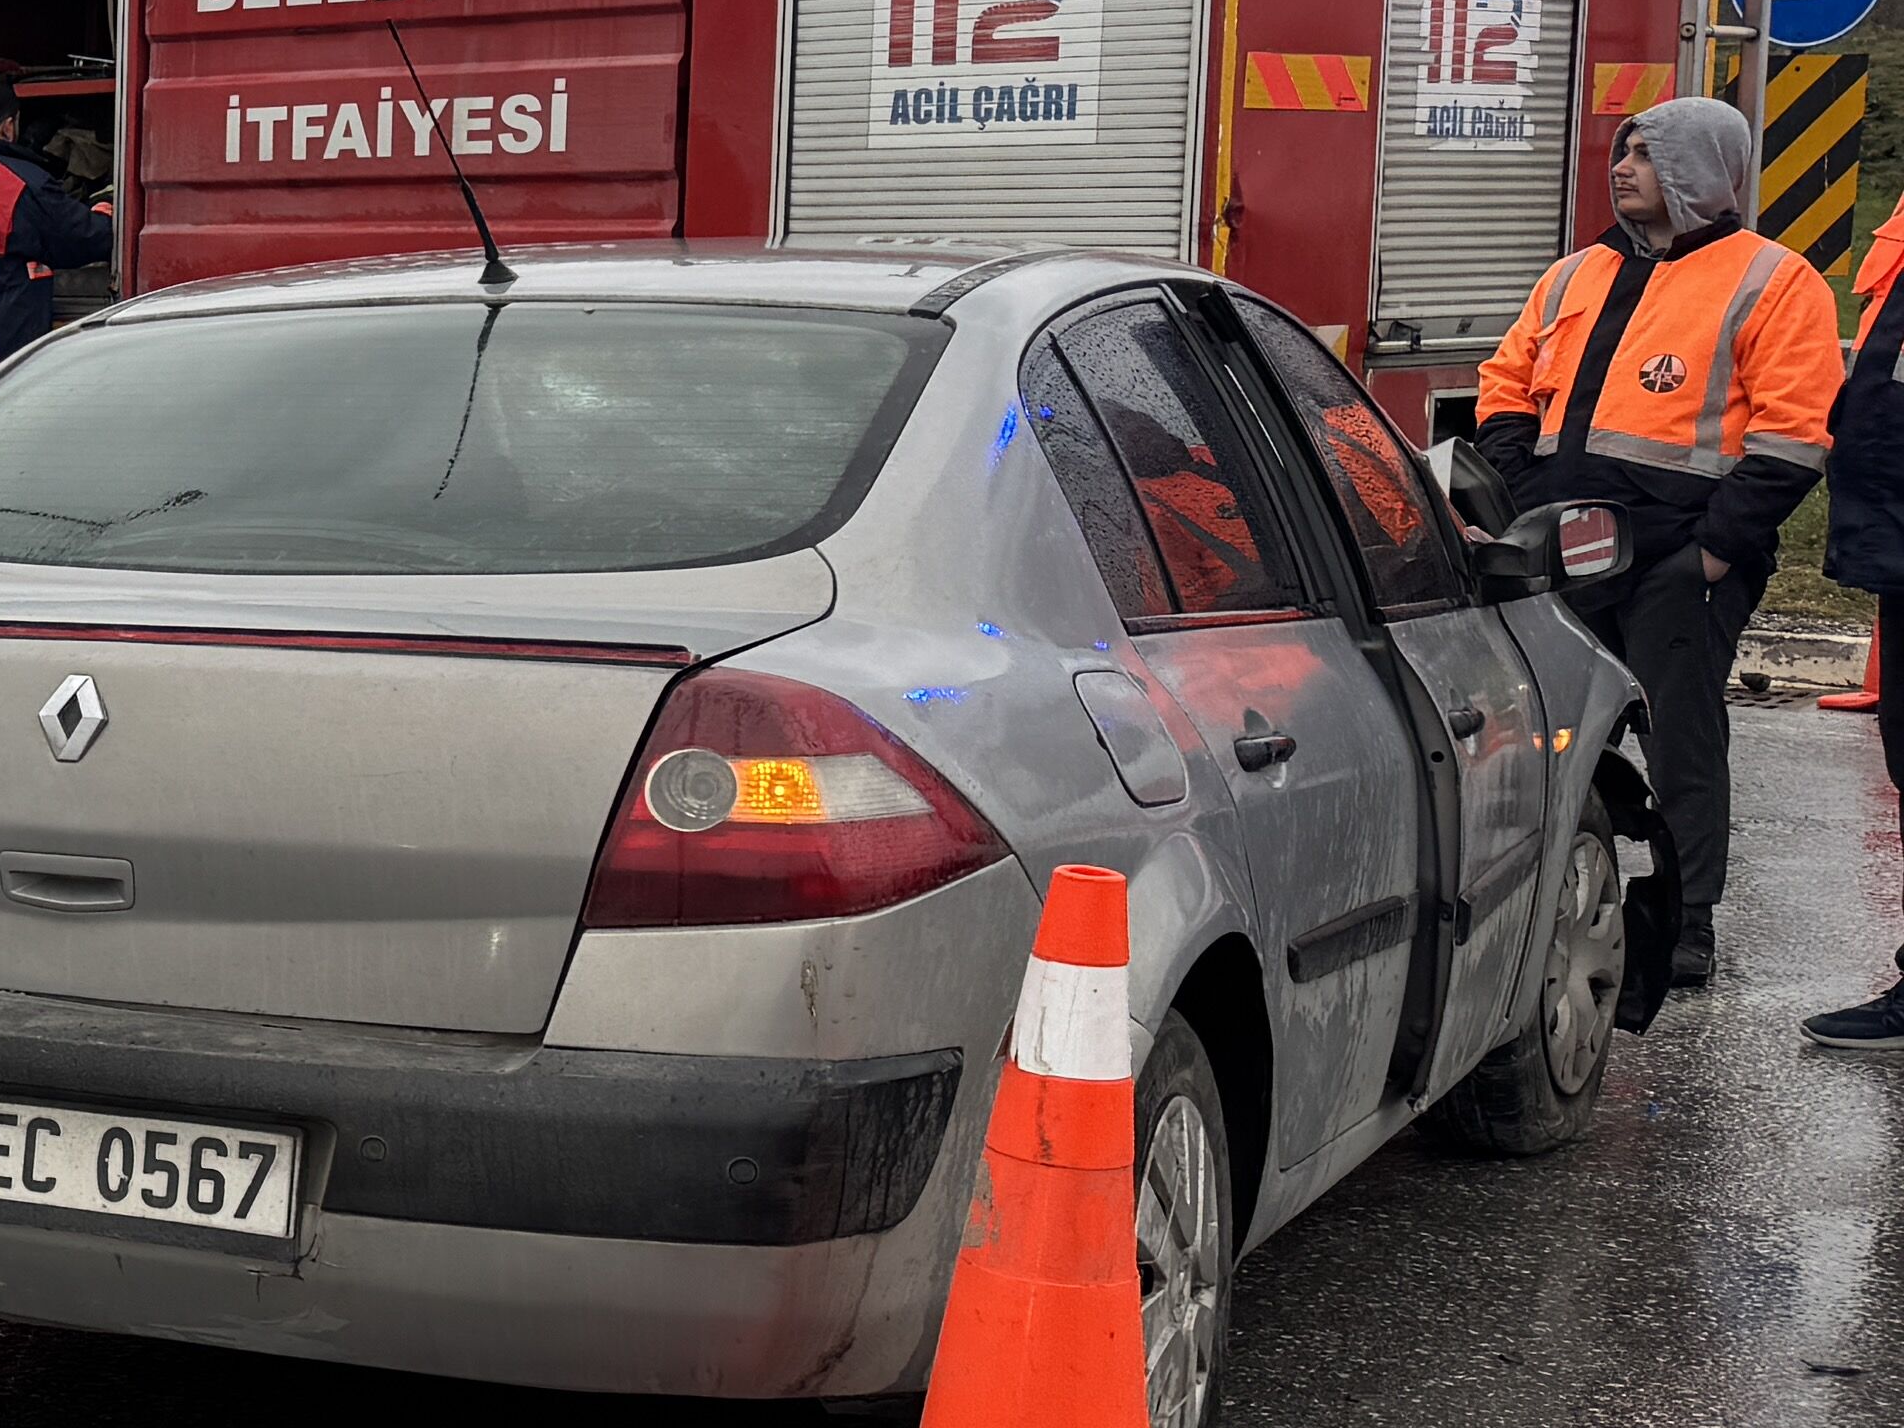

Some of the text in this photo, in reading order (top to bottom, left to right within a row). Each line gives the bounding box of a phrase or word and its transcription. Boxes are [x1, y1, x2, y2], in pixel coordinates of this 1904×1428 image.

[224, 76, 569, 164] İTFAİYESİ
[889, 76, 1078, 131] ACİL ÇAĞRI
[95, 1125, 278, 1220] 0567
